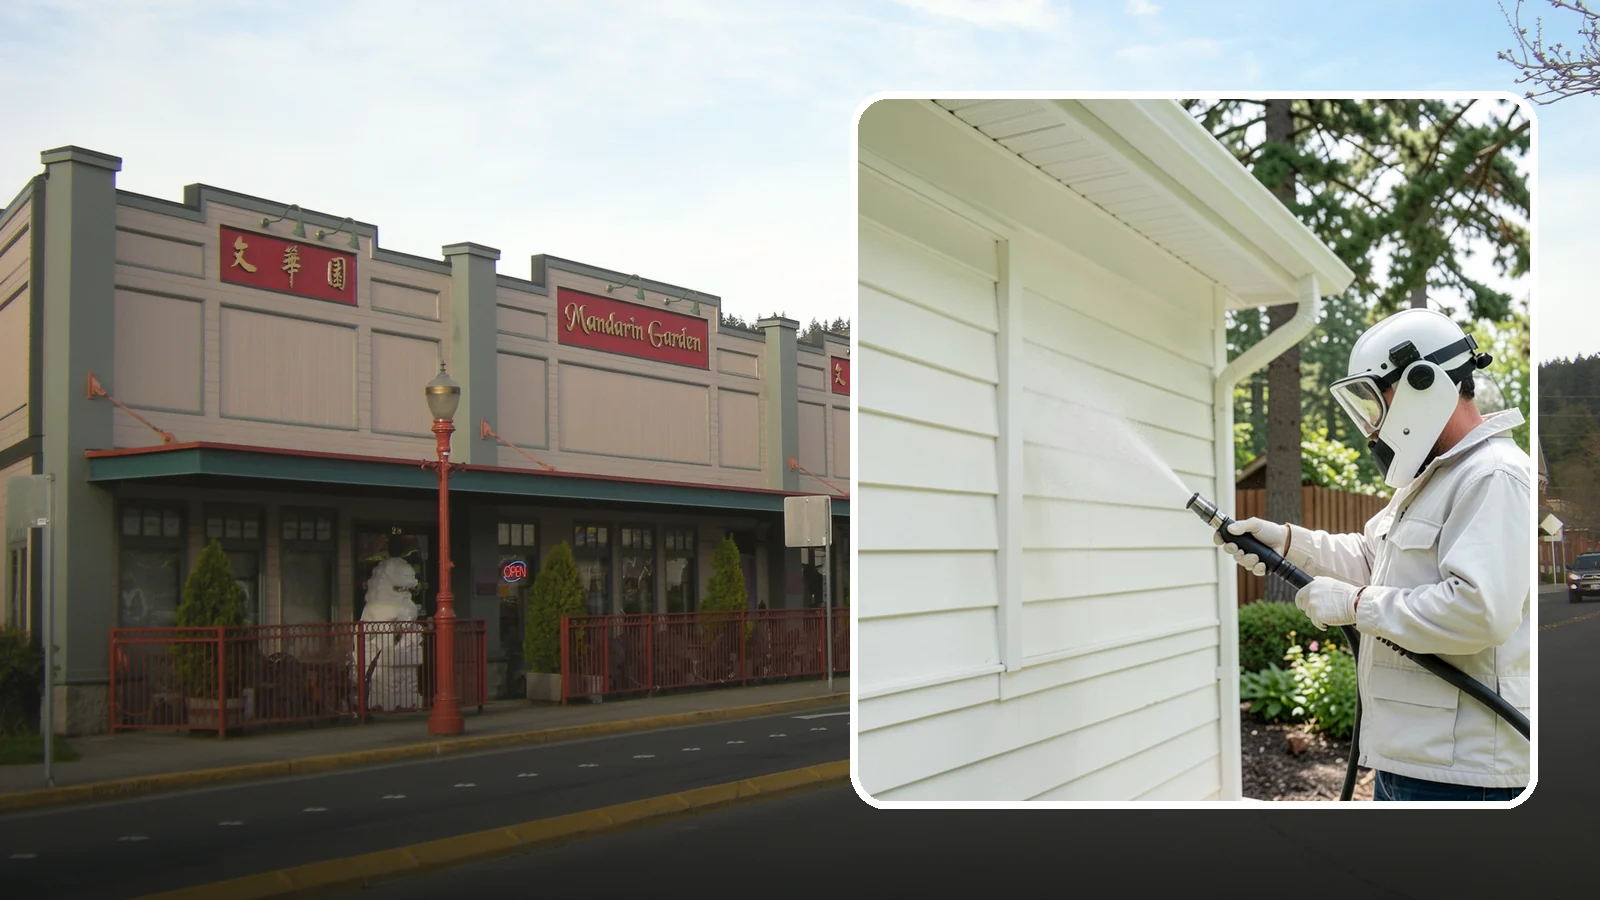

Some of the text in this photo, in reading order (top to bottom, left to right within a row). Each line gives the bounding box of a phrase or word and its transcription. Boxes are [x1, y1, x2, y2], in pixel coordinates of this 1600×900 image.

[231, 235, 347, 291] 文華園
[564, 302, 701, 352] Mandarin Garden
[503, 565, 527, 578] OPEN
